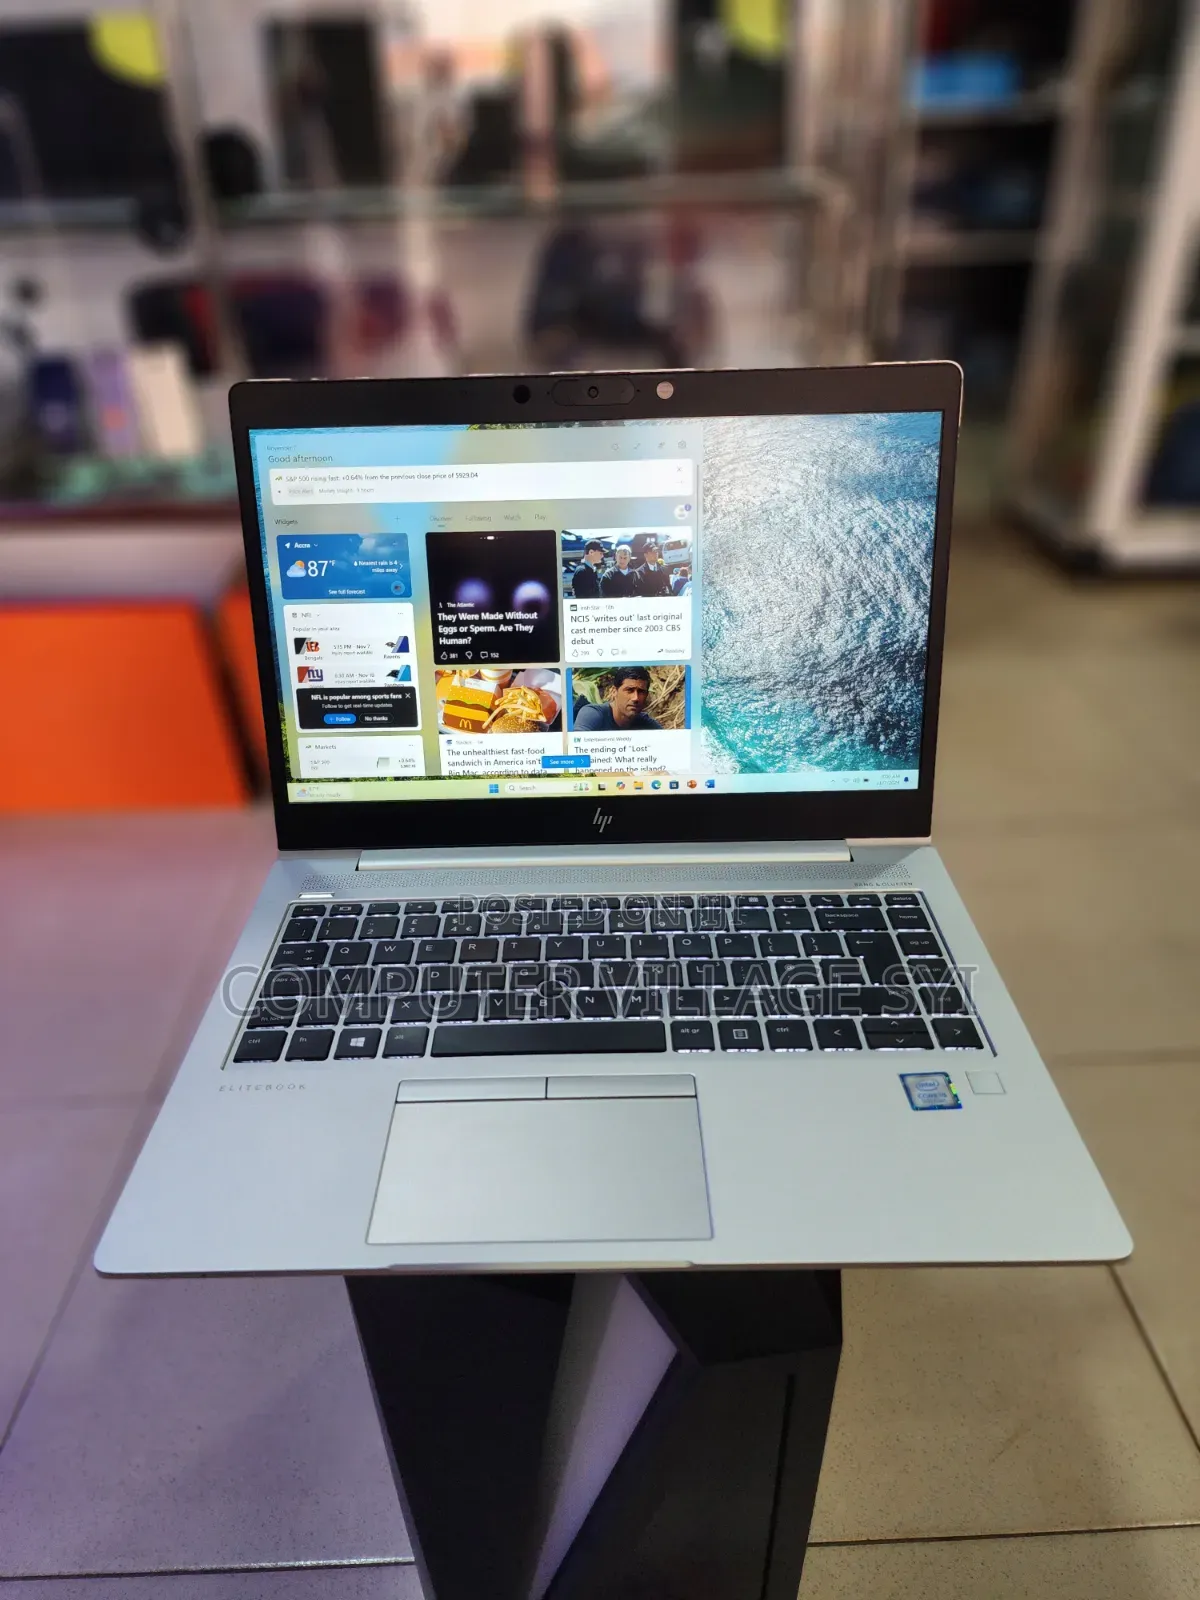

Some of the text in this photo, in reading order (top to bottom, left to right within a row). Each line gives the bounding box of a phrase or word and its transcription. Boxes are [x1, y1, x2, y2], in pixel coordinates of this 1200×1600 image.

[268, 454, 333, 463] Good afternoon
[391, 473, 415, 482] previous
[433, 473, 447, 481] price
[274, 518, 298, 526] Widgets
[534, 514, 546, 522] Play
[308, 560, 328, 577] 87
[437, 613, 457, 622] They
[481, 612, 503, 620] Made
[505, 611, 538, 620] Without
[570, 615, 590, 623] NCIS
[619, 614, 635, 622] out'
[652, 613, 683, 623] original
[438, 625, 457, 635] Eggs
[470, 624, 497, 634] Sperm.
[499, 624, 513, 632] Are
[514, 624, 534, 633] They
[588, 626, 620, 634] member
[666, 624, 681, 632] CBS
[439, 637, 472, 645] Human?
[462, 748, 509, 756] unhealthiest
[511, 747, 545, 755] fast-food
[574, 746, 588, 754] The
[590, 746, 616, 755] ending
[637, 756, 657, 764] really
[592, 807, 613, 833] hp
[401, 1001, 411, 1009] X
[219, 1083, 306, 1092] ELITEBOOK
